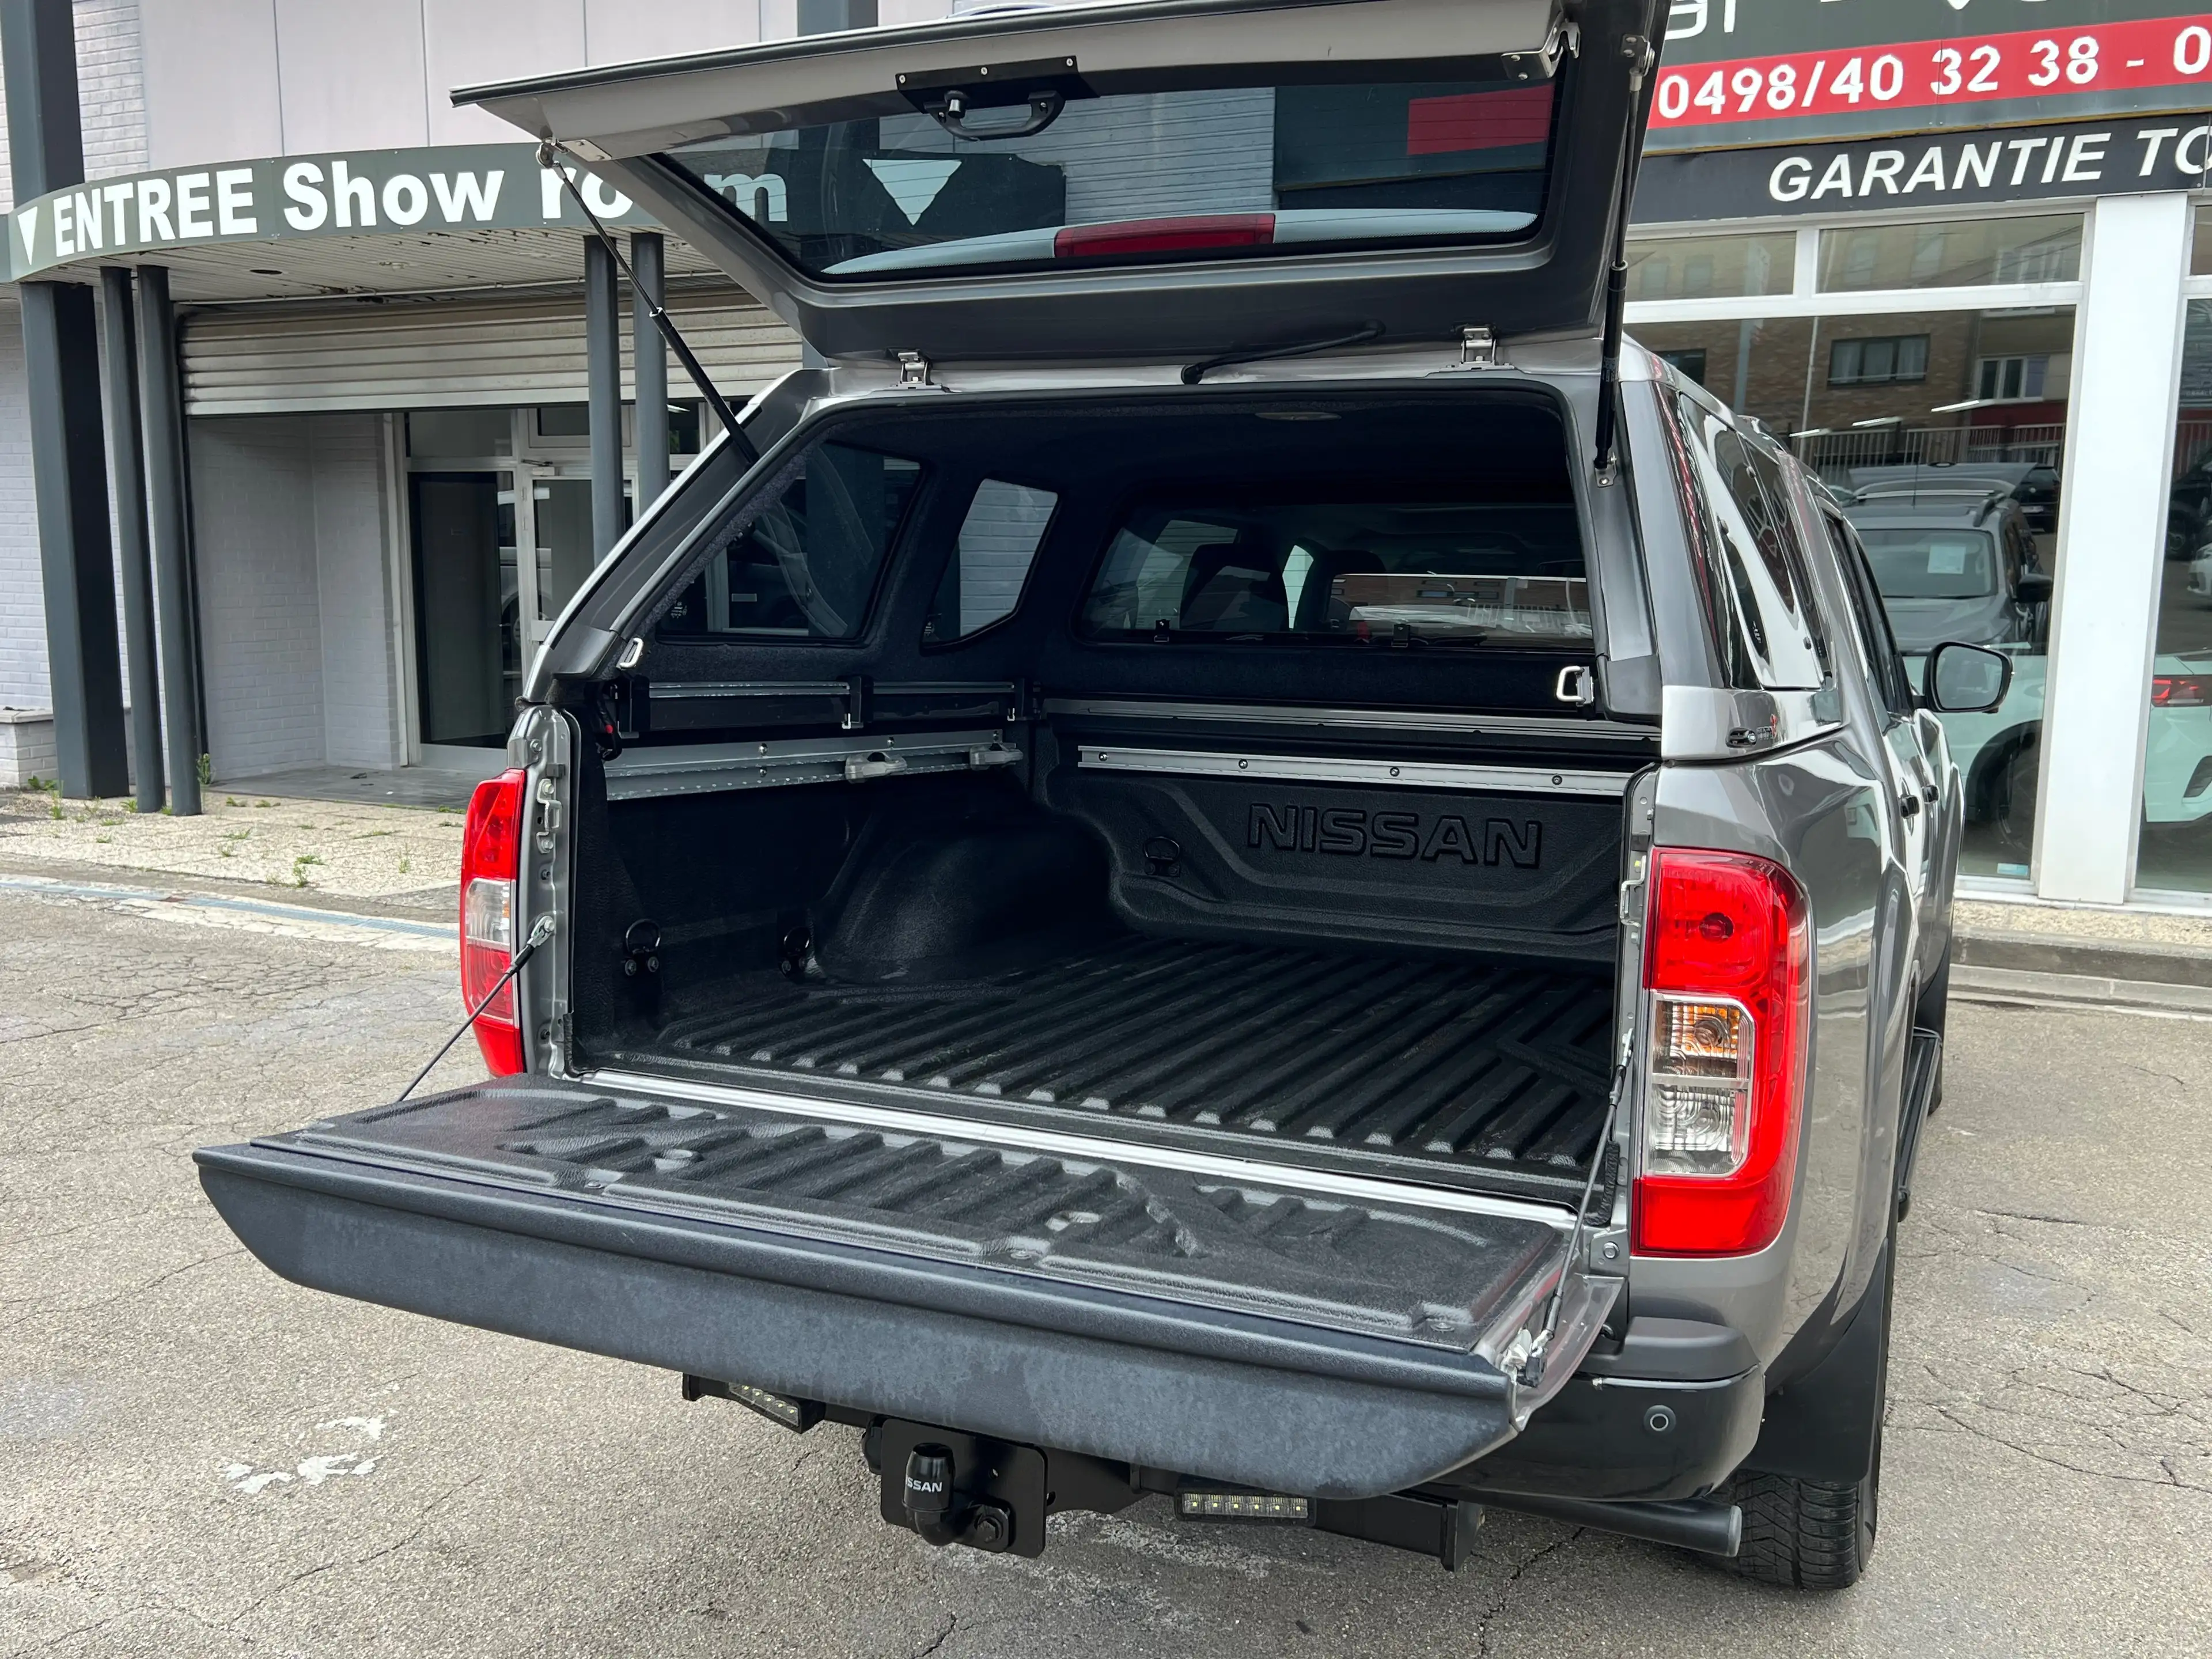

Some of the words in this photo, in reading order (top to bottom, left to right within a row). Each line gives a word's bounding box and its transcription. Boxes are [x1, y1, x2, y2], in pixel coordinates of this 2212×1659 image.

[1658, 54, 1904, 119] 0498/40
[1930, 45, 2001, 96] 32
[2027, 35, 2100, 87] 38
[1768, 132, 2112, 202] GARANTIE
[52, 168, 258, 257] ENTREE
[283, 160, 505, 231] Show
[540, 166, 788, 222] rom
[1247, 802, 1543, 869] NISSAN
